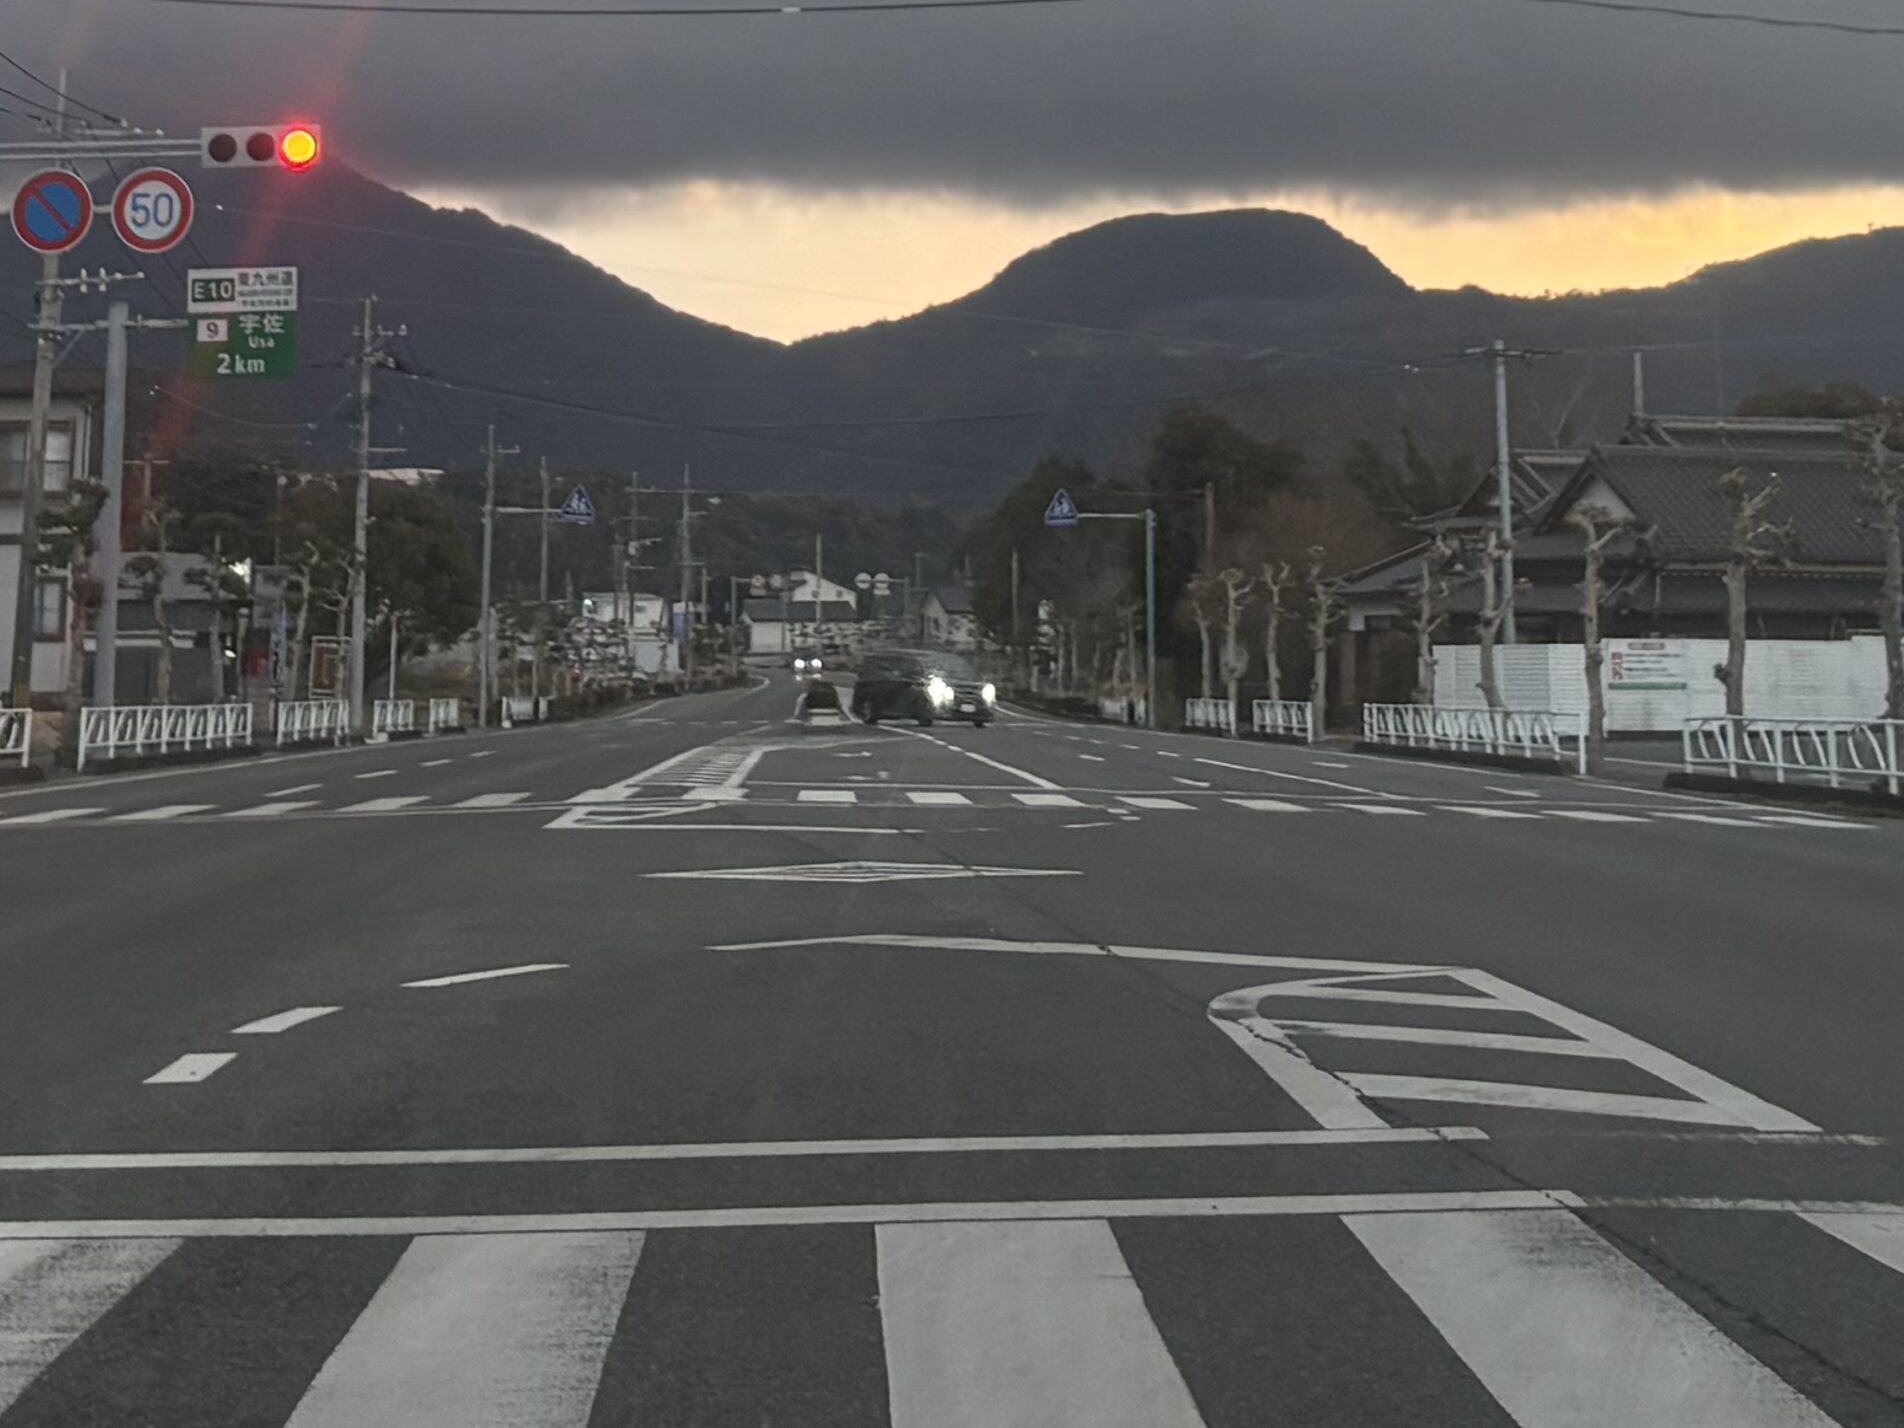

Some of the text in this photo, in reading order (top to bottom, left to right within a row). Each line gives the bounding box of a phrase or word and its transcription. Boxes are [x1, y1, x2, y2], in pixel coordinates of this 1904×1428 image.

[132, 192, 173, 228] 50
[194, 281, 233, 300] E10
[206, 322, 219, 339] 9
[239, 313, 286, 335] 宇佐
[248, 336, 275, 349] Usa
